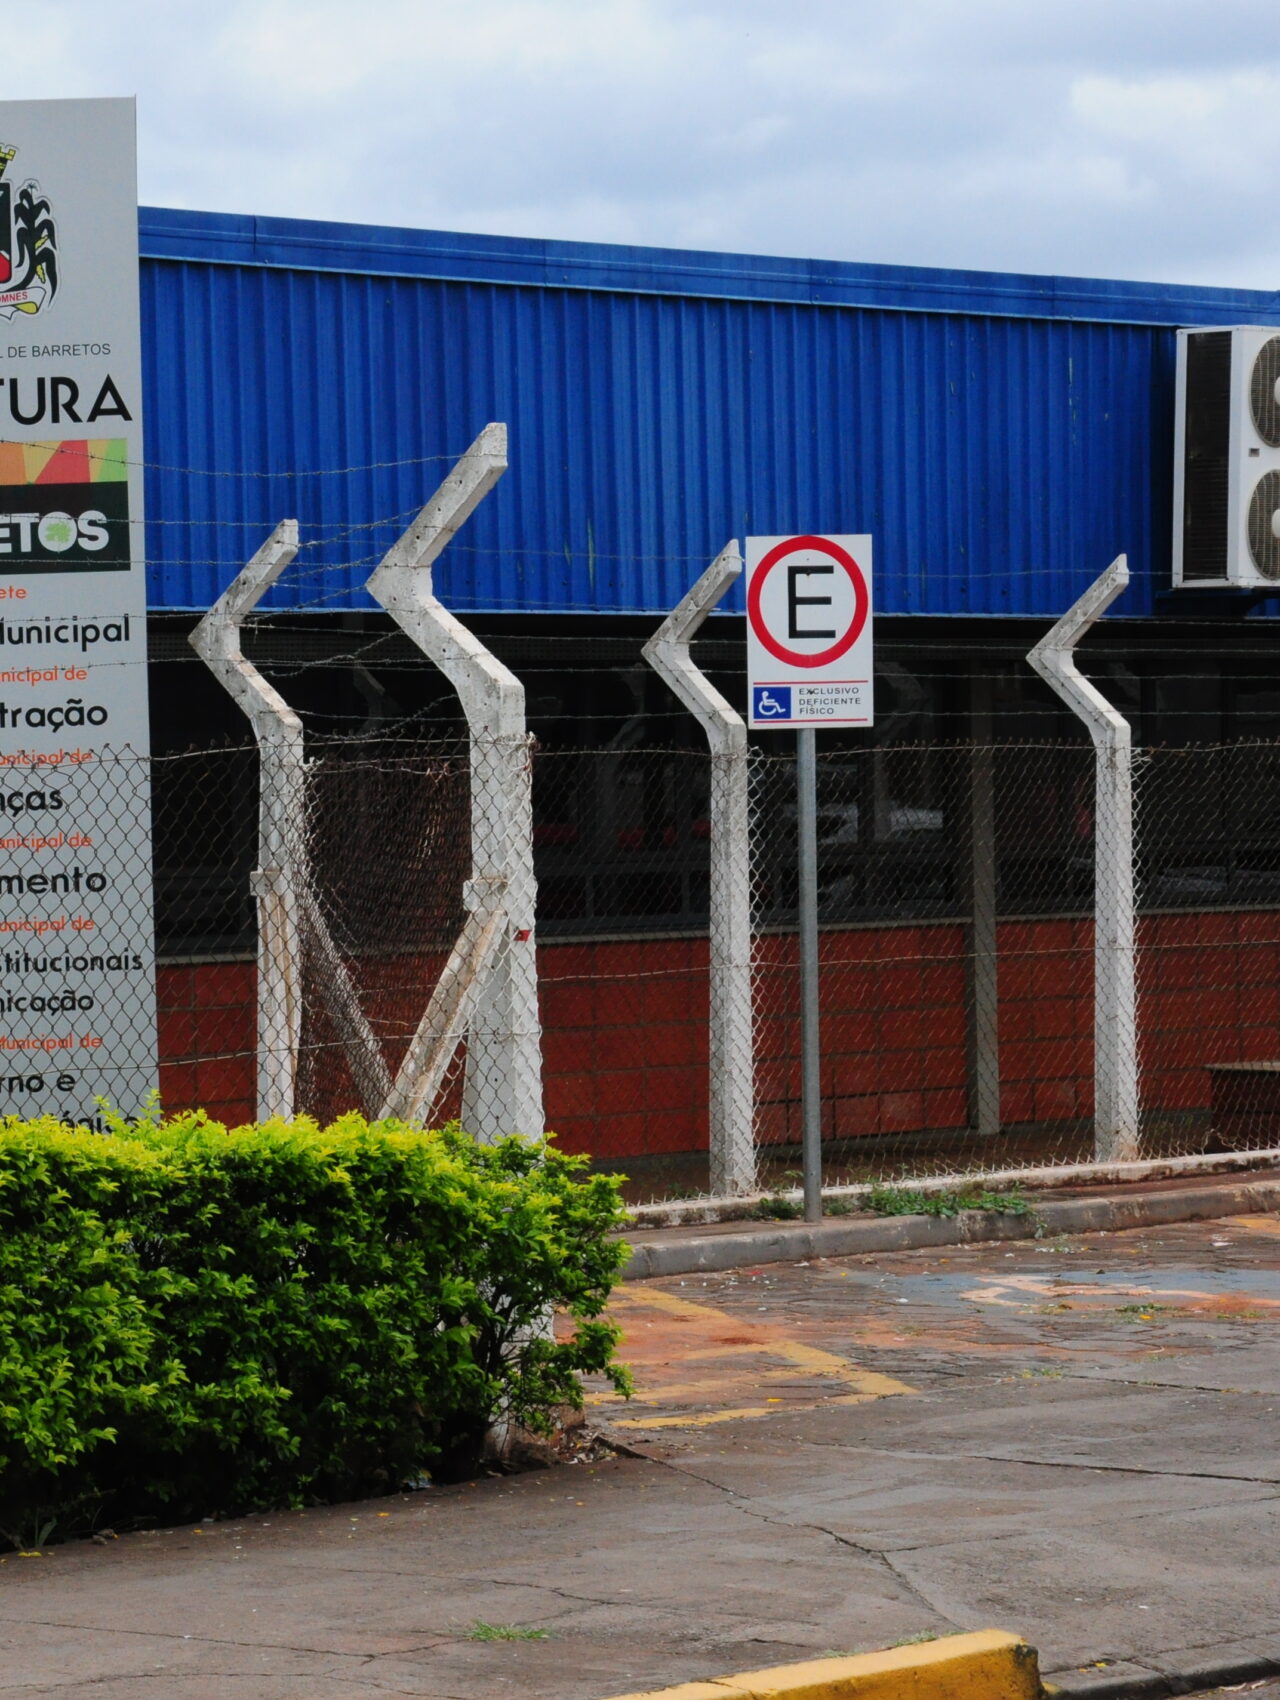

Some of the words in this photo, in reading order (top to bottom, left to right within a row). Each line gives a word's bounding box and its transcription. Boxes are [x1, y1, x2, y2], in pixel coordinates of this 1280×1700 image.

[8, 346, 27, 359] DE
[32, 343, 111, 358] BARRETOS
[787, 565, 836, 639] E
[64, 665, 87, 681] de
[799, 687, 859, 695] EXCLUSIVO
[799, 698, 861, 706] DEFICIENTE
[70, 748, 93, 764] de
[68, 832, 93, 848] de
[71, 915, 95, 931] de
[79, 1033, 103, 1049] de
[56, 1074, 76, 1092] e
